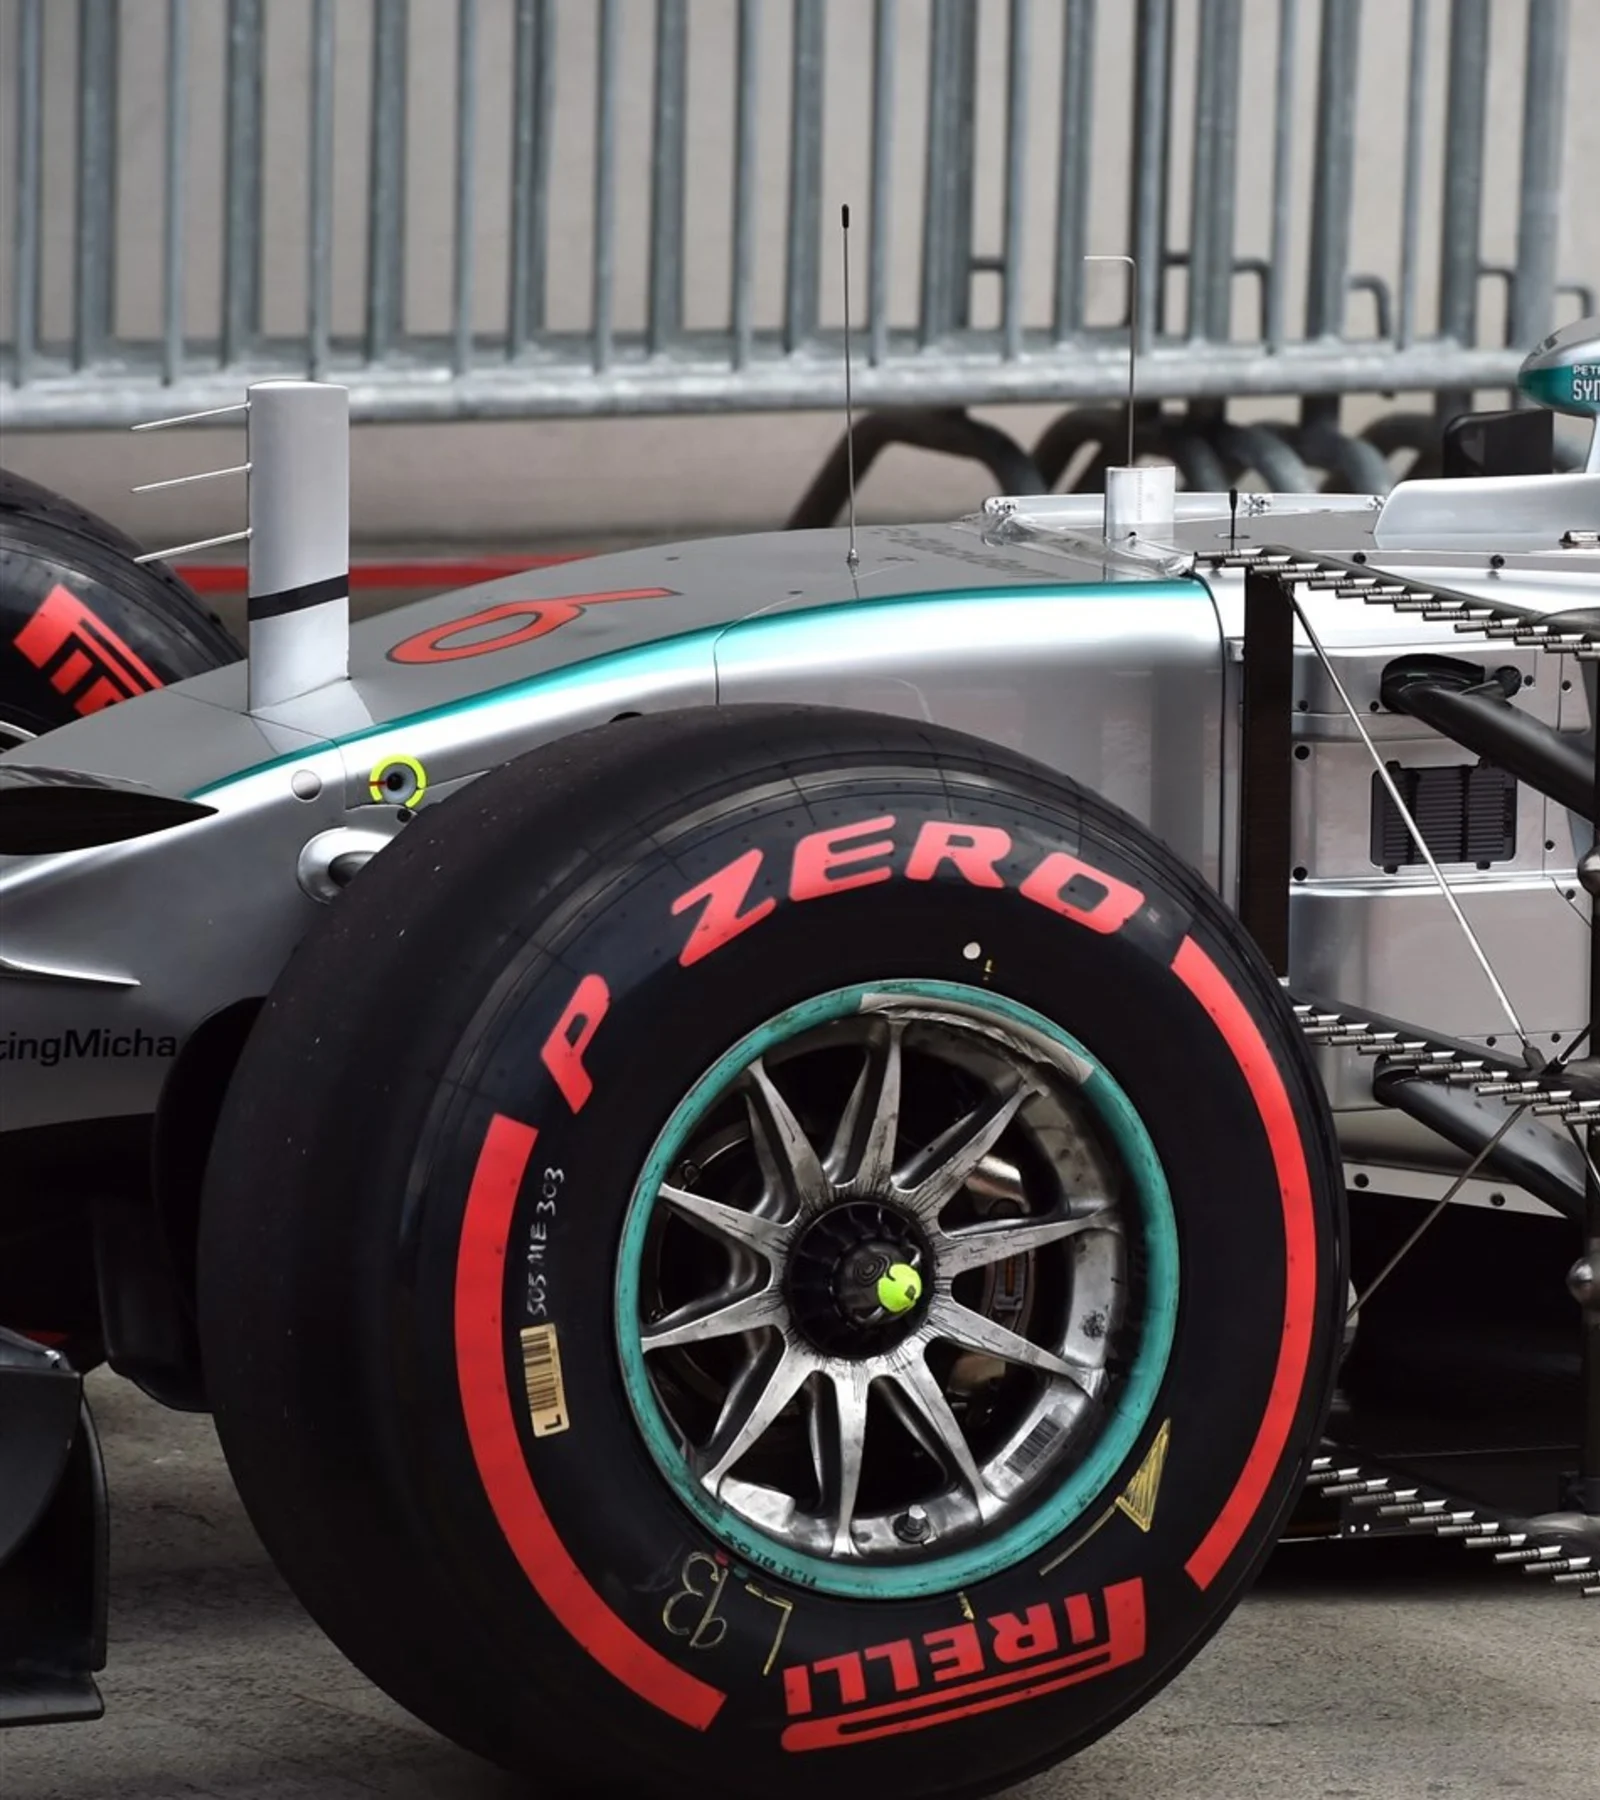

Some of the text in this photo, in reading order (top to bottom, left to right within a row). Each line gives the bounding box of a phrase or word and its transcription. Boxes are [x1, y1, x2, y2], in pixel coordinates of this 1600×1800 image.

[540, 814, 1146, 1114] P ZERO
[781, 1577, 1145, 1752] PIRELLI
